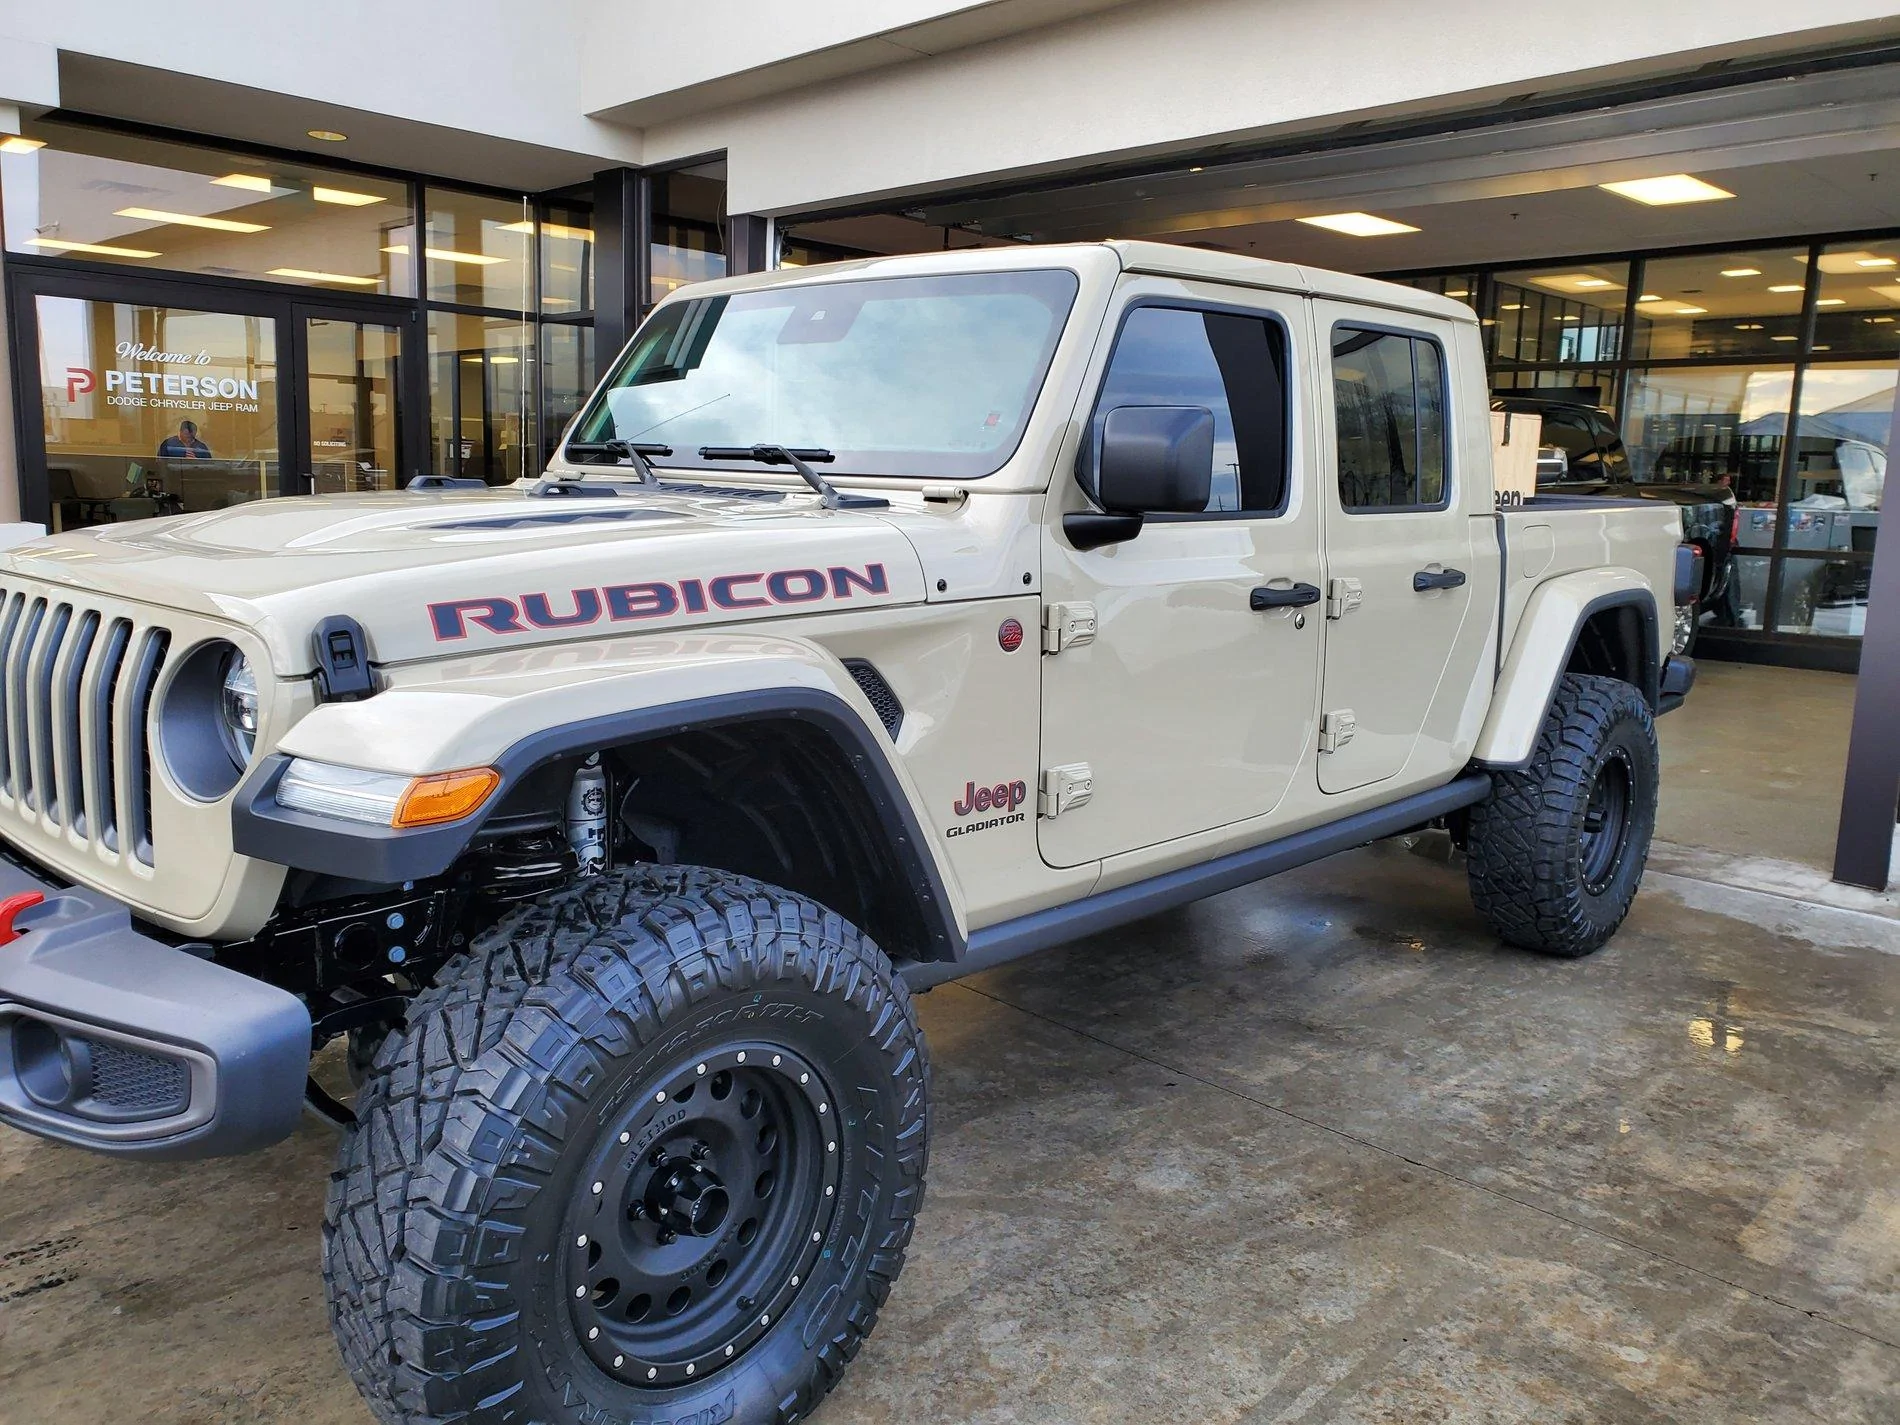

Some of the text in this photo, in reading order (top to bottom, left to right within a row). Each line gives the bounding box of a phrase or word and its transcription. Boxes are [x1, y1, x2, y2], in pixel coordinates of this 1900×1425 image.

[116, 341, 211, 366] Welcome to
[105, 369, 258, 400] PETERSON
[107, 396, 258, 413] DODGE CHRYSLER JEEP RAM
[427, 563, 889, 642] RUBICON
[954, 780, 1026, 816] Jeep
[946, 813, 1025, 838] GLADIATOR
[627, 1109, 687, 1169] METHOD
